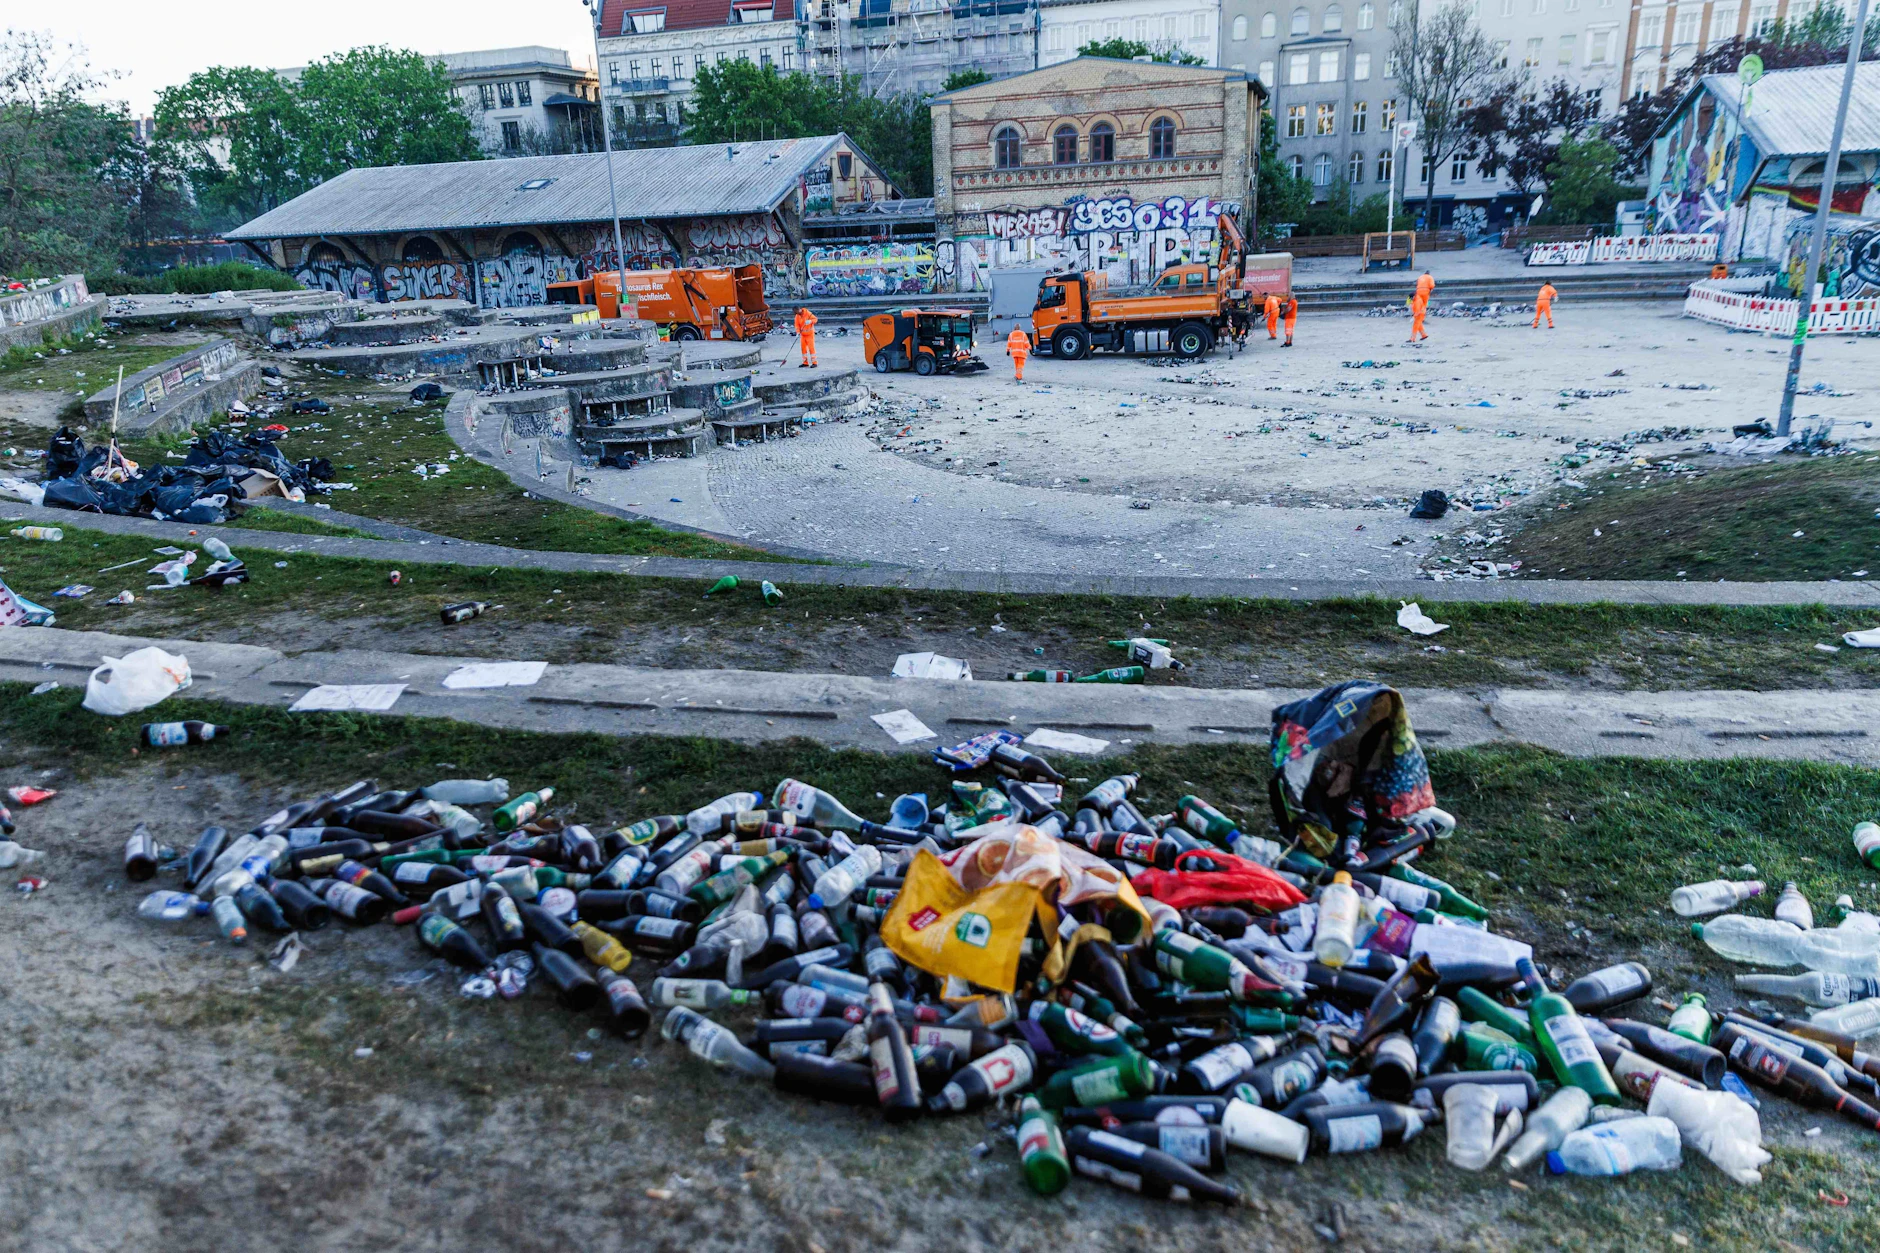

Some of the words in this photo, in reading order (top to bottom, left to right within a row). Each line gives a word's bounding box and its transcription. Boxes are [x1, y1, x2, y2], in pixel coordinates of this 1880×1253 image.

[615, 283, 651, 292] Tonosaurus
[652, 282, 664, 291] Rex
[638, 291, 672, 302] rischfleisch.
